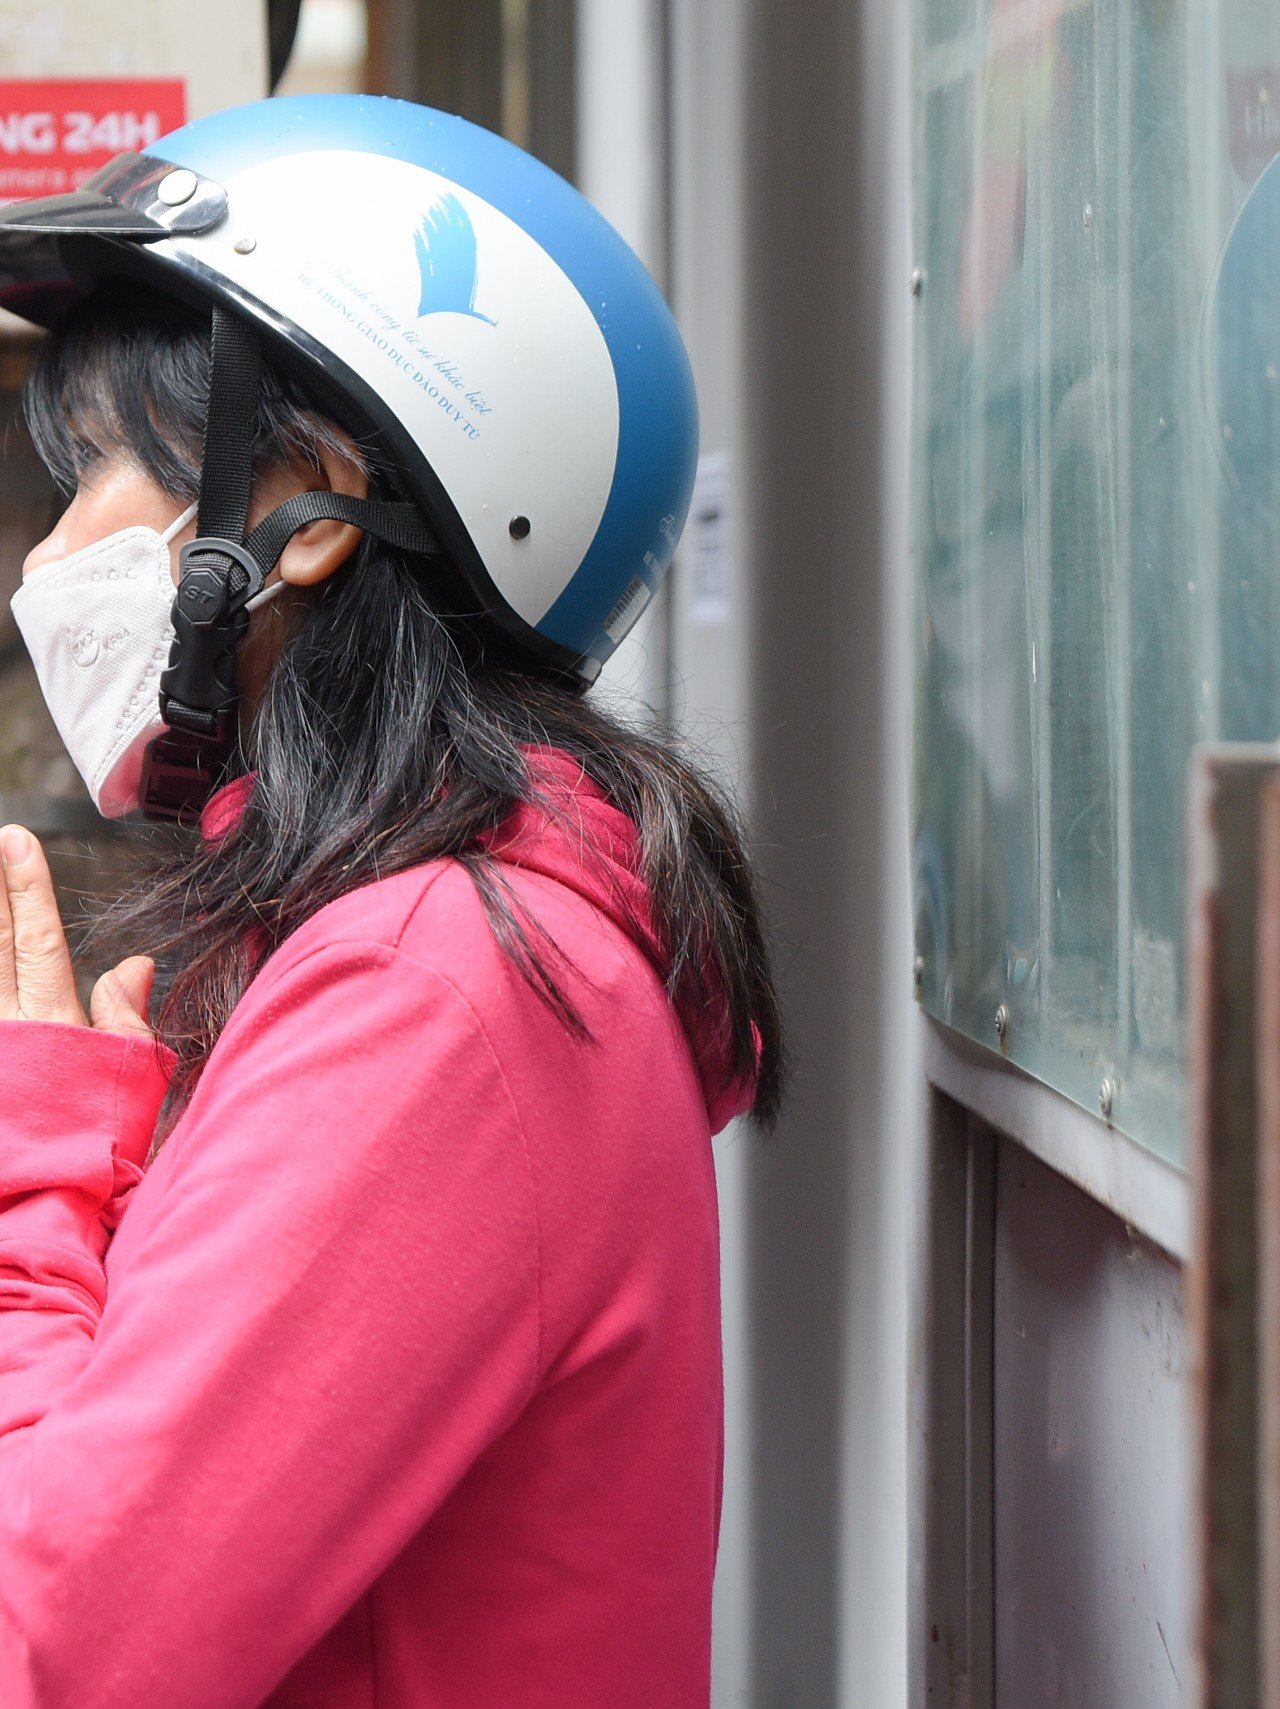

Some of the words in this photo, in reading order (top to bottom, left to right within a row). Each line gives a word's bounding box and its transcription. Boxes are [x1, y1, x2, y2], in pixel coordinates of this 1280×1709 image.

[63, 111, 159, 154] 24H
[437, 396, 464, 422] DUY
[184, 585, 216, 605] ST
